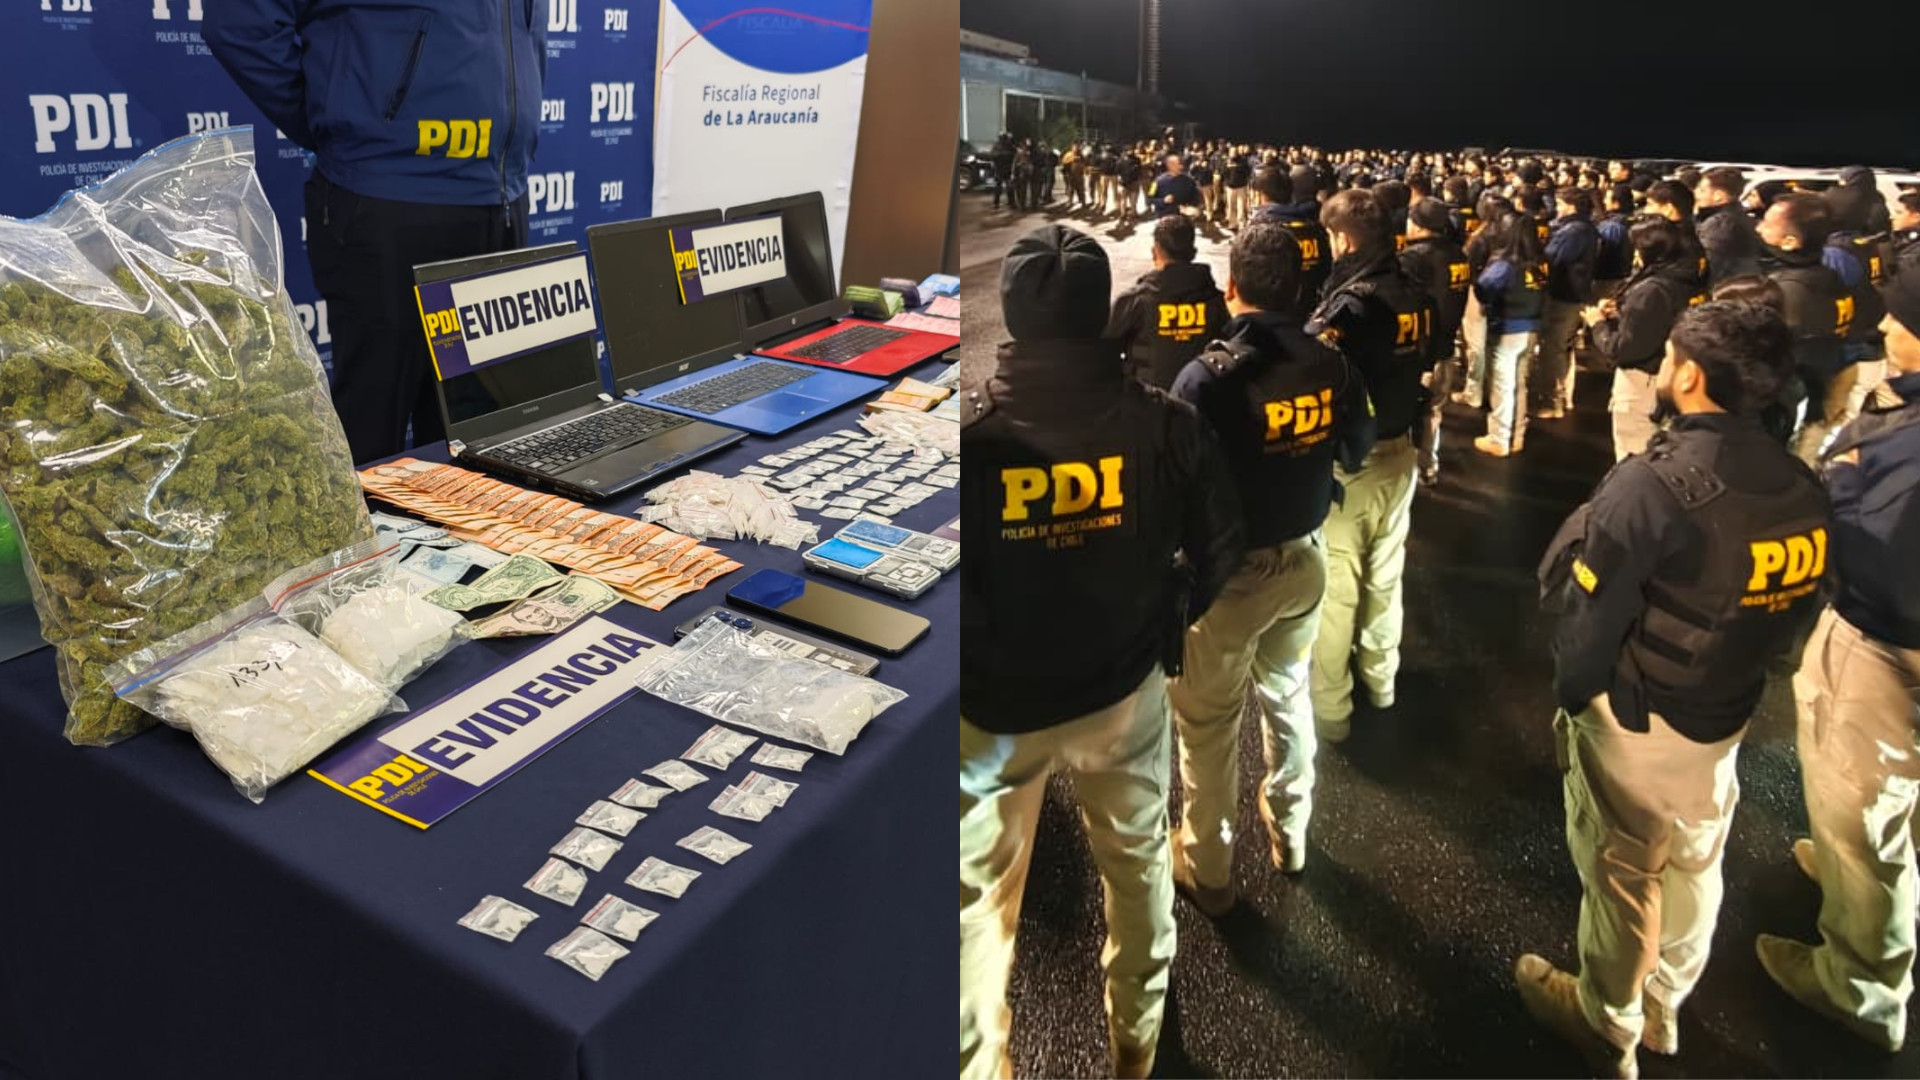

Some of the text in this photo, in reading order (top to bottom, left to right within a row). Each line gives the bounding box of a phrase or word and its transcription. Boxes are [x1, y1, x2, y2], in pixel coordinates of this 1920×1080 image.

[604, 9, 628, 31] PDI
[541, 99, 565, 122] PDI
[590, 83, 634, 123] PDI
[702, 83, 820, 105] Fiscalía Regional
[29, 93, 132, 153] PDI
[703, 106, 819, 126] de La Araucanía
[416, 119, 492, 158] PDI
[527, 171, 575, 215] PDI
[600, 181, 623, 203] PDI
[674, 235, 782, 276] PDI EVIDENCIA
[426, 278, 591, 342] PDI EVIDENCIA
[1158, 302, 1206, 328] PDI
[1264, 388, 1333, 441] PDI
[1001, 456, 1123, 521] PDI
[1747, 528, 1827, 592] PDI
[348, 632, 657, 800] PDI EVIDENCIA
